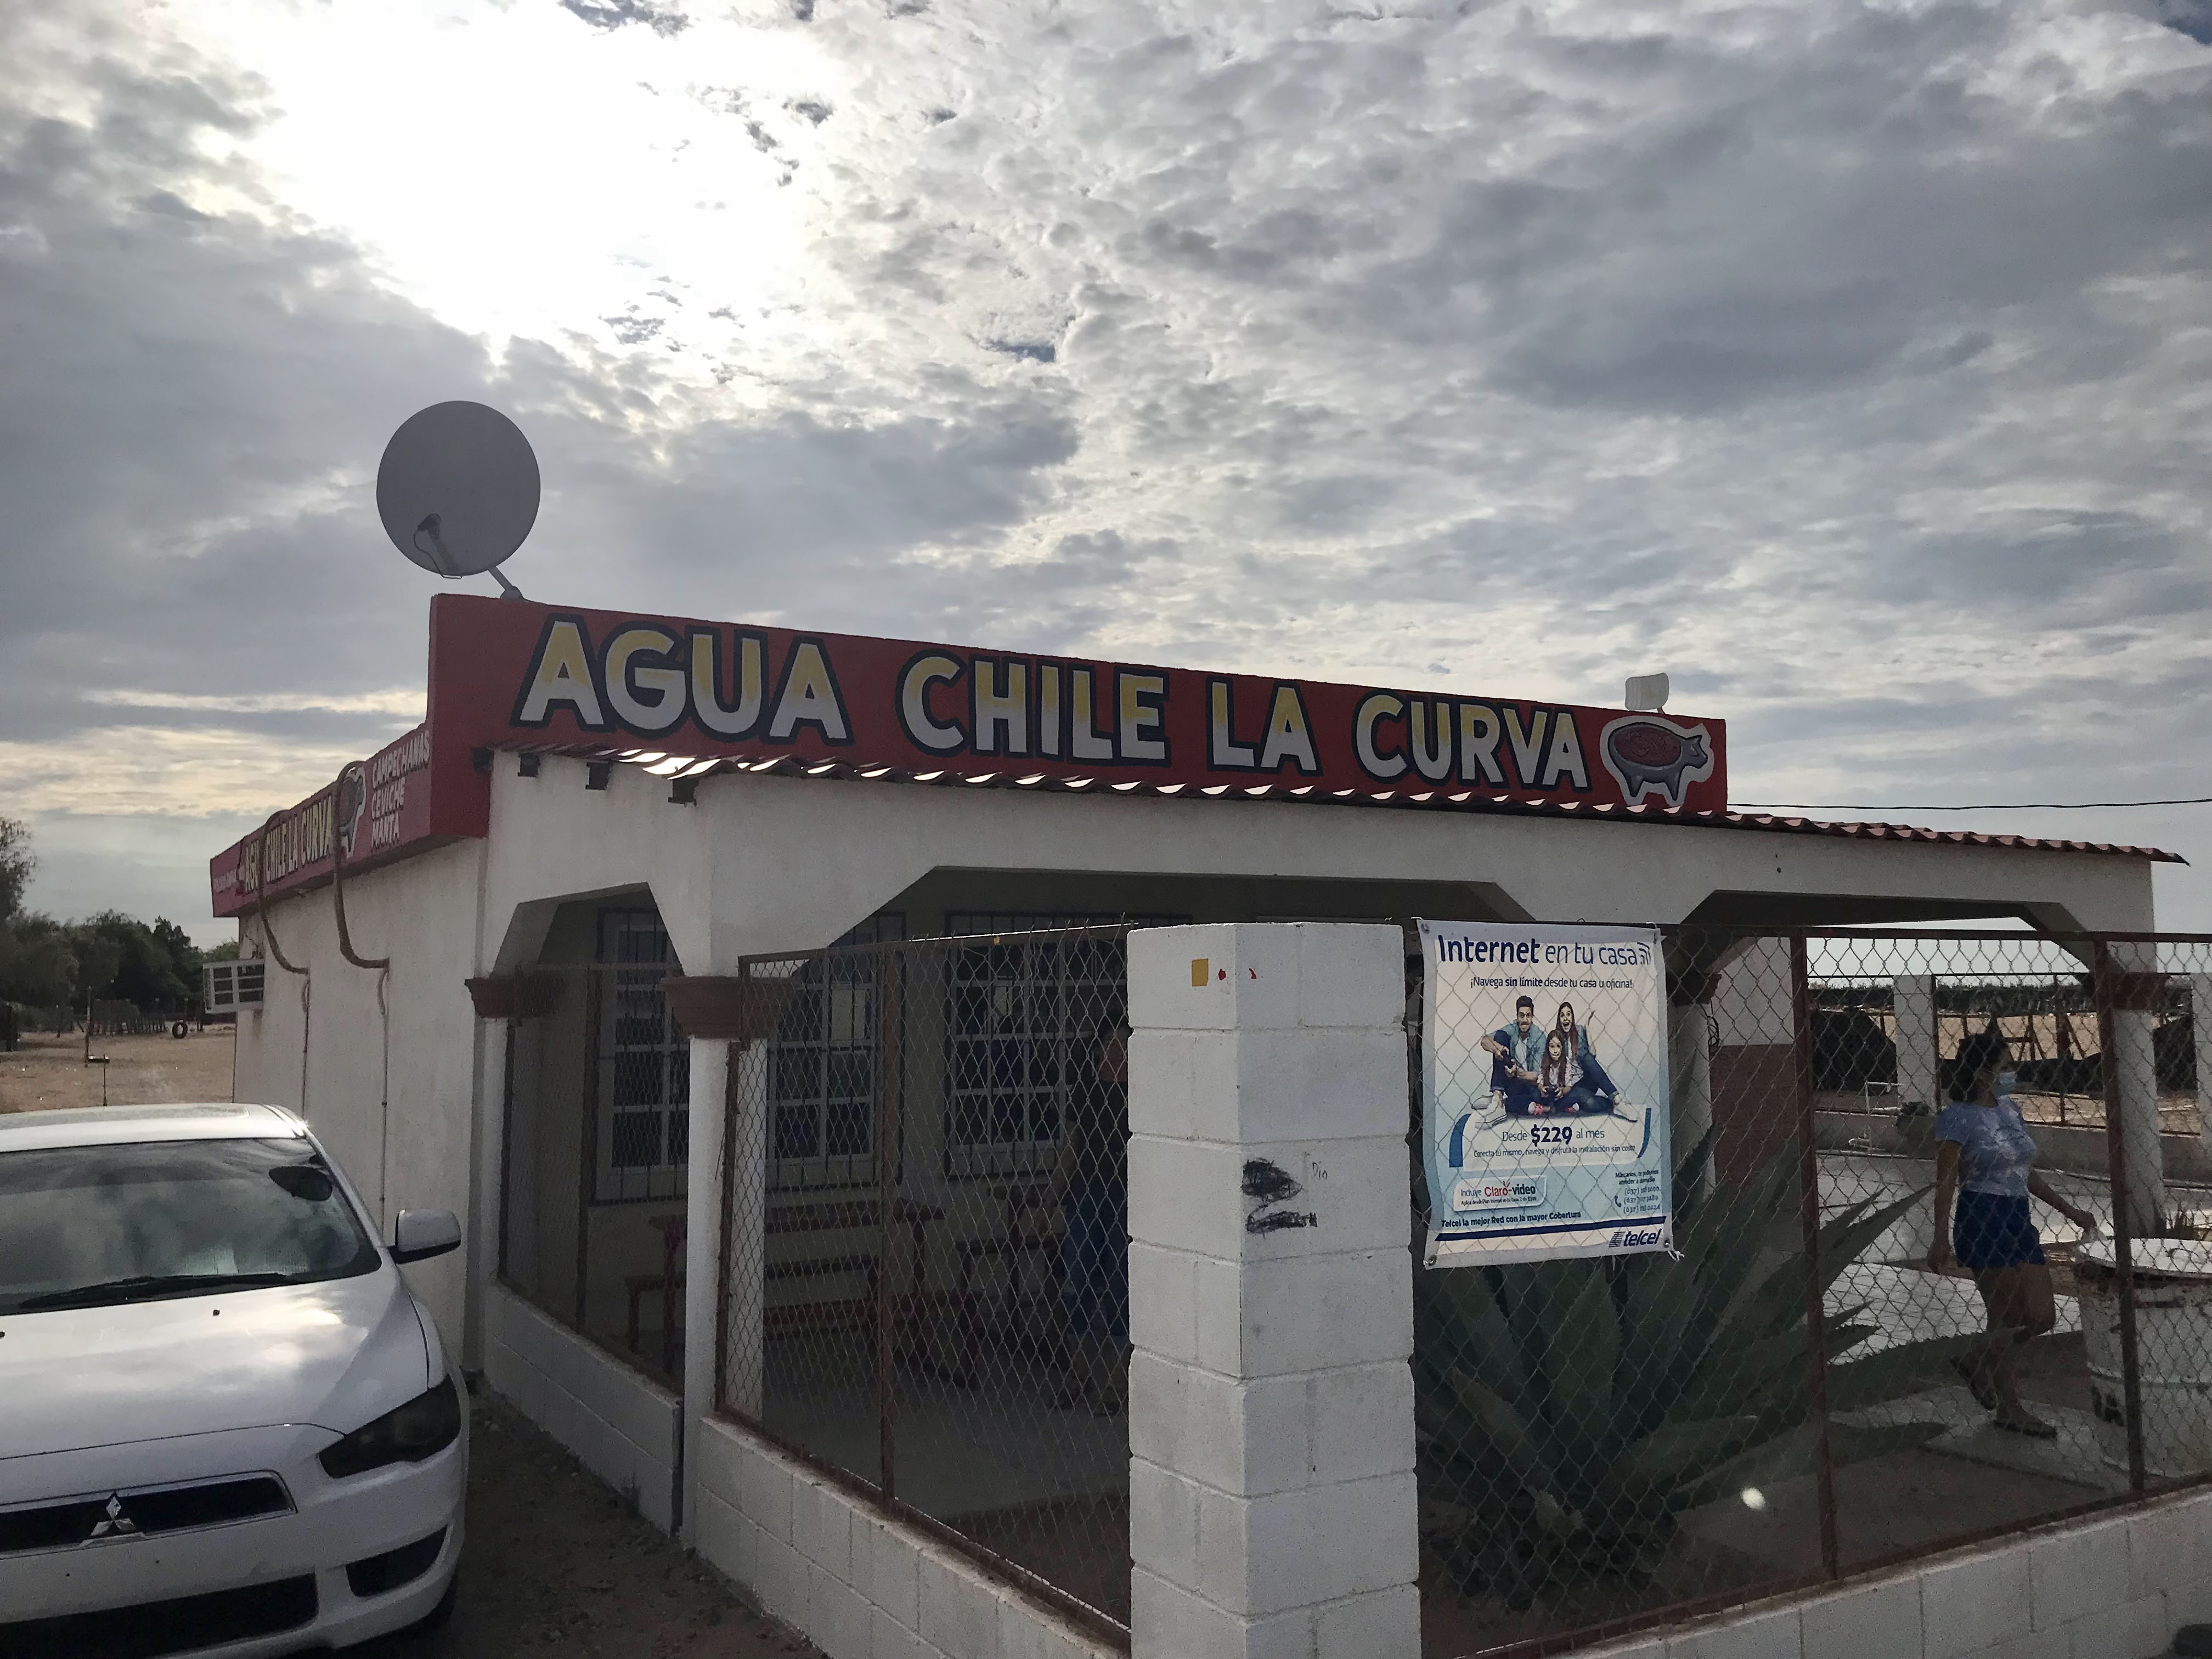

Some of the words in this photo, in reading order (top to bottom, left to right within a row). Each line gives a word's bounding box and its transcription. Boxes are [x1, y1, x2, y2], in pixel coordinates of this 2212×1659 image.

[516, 618, 850, 741] AGUA
[899, 653, 1167, 763] CHILE
[1209, 679, 1319, 772] LA
[1353, 693, 1590, 790] CURVA
[371, 811, 399, 848] MANTA
[245, 839, 259, 893] AGU
[266, 823, 286, 882] CHILE
[288, 815, 298, 873] LA
[302, 795, 332, 867] CURVA
[1438, 935, 1540, 963] Internet
[1545, 945, 1568, 964] en
[1575, 942, 1593, 964] tu
[1598, 947, 1638, 966] casa
[1470, 977, 1503, 989] ¡Navega
[1505, 977, 1517, 987] sin
[1519, 977, 1543, 987] límite
[1544, 977, 1568, 988] desde
[1570, 978, 1578, 988] tu
[1579, 979, 1597, 988] casa
[1599, 980, 1604, 988] u
[1606, 979, 1633, 990] oficina!
[1502, 1130, 1527, 1142] Desde
[1531, 1124, 1572, 1147] $229
[1576, 1128, 1583, 1139] al
[1585, 1130, 1605, 1138] mes
[1550, 1147, 1571, 1155] disfruta
[1578, 1144, 1610, 1153] instalación
[1611, 1144, 1621, 1152] sin
[1461, 1189, 1482, 1198] Incluye
[1441, 1218, 1462, 1227] Telcel
[1470, 1217, 1491, 1227] mejor
[1492, 1216, 1504, 1224] Red
[1527, 1214, 1548, 1222] mayor
[1549, 1211, 1582, 1220] Cobertura
[1623, 1228, 1662, 1247] telcel
